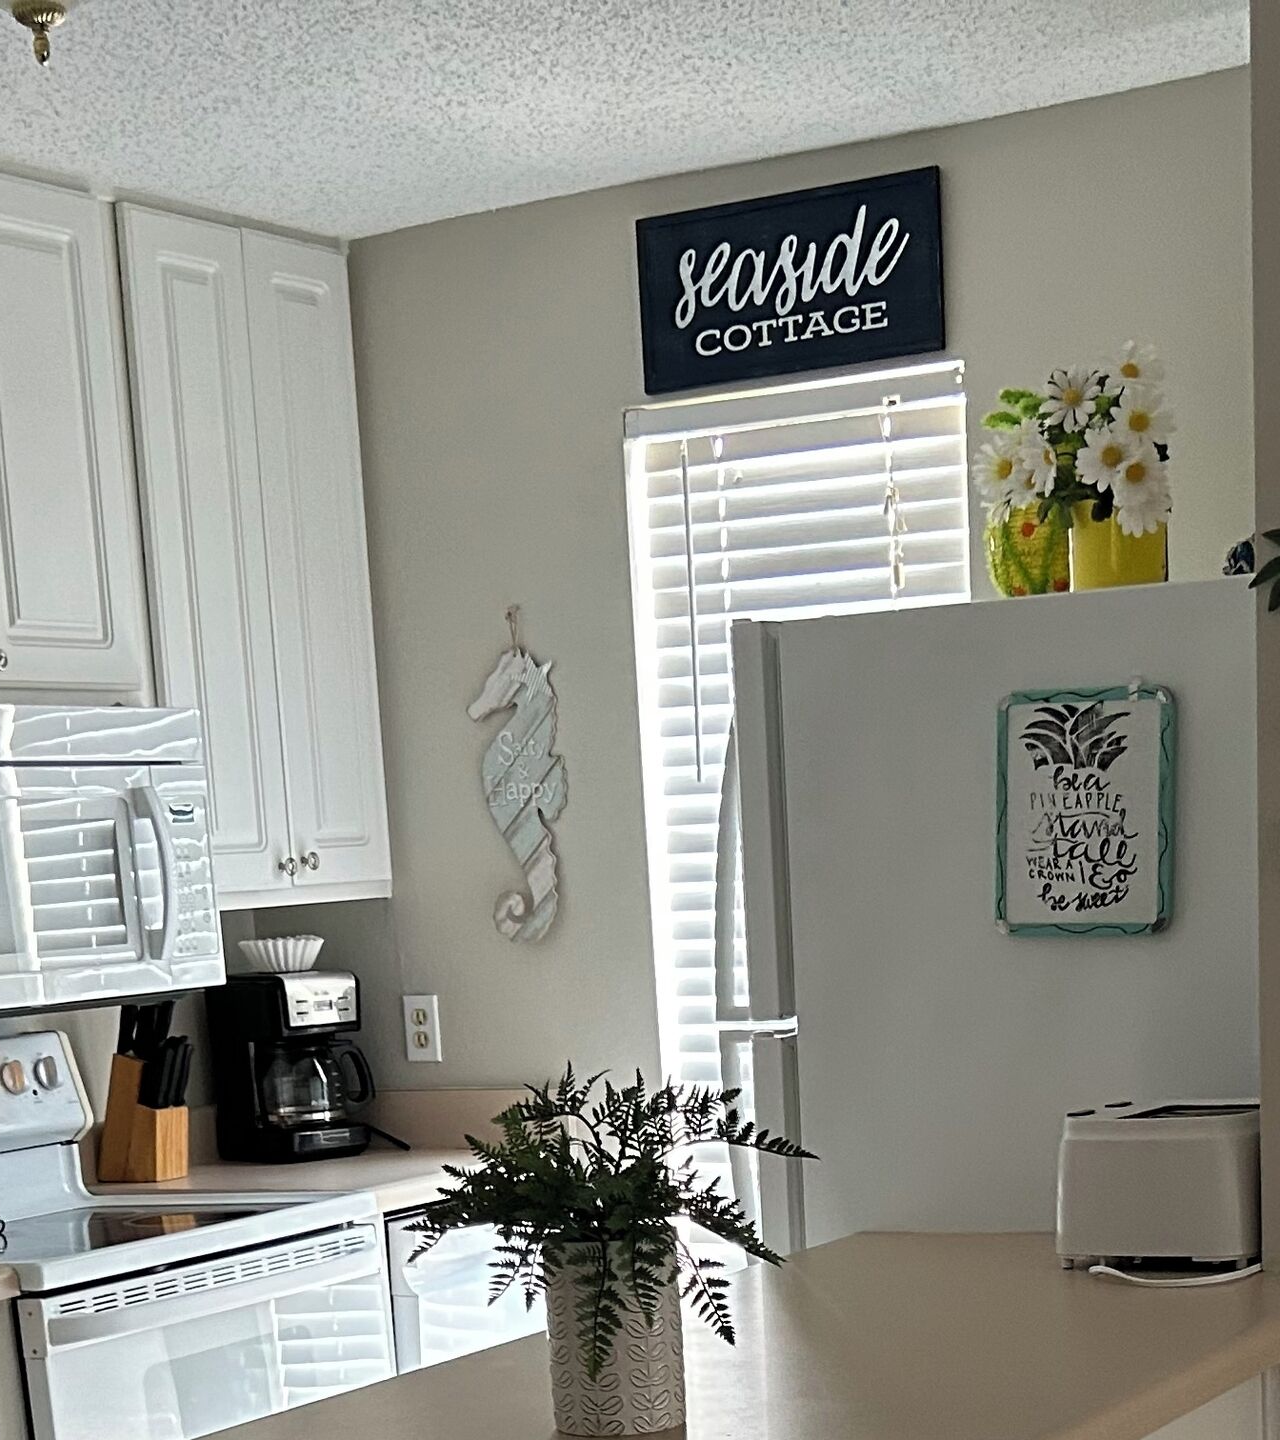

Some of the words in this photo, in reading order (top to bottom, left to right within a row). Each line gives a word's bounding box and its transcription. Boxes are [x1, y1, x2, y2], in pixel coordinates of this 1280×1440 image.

[675, 204, 911, 329] seaside
[695, 301, 888, 356] COTTAGE
[498, 731, 546, 765] Salty
[486, 775, 557, 806] Happy
[1052, 765, 1082, 791] be
[1083, 773, 1111, 791] a
[1030, 791, 1123, 813] PINEAPPLE
[1026, 855, 1061, 870] WEAR
[1065, 859, 1073, 870] A
[1028, 868, 1076, 883] CROWN
[1037, 882, 1071, 911] be
[1072, 885, 1130, 912] sweet
